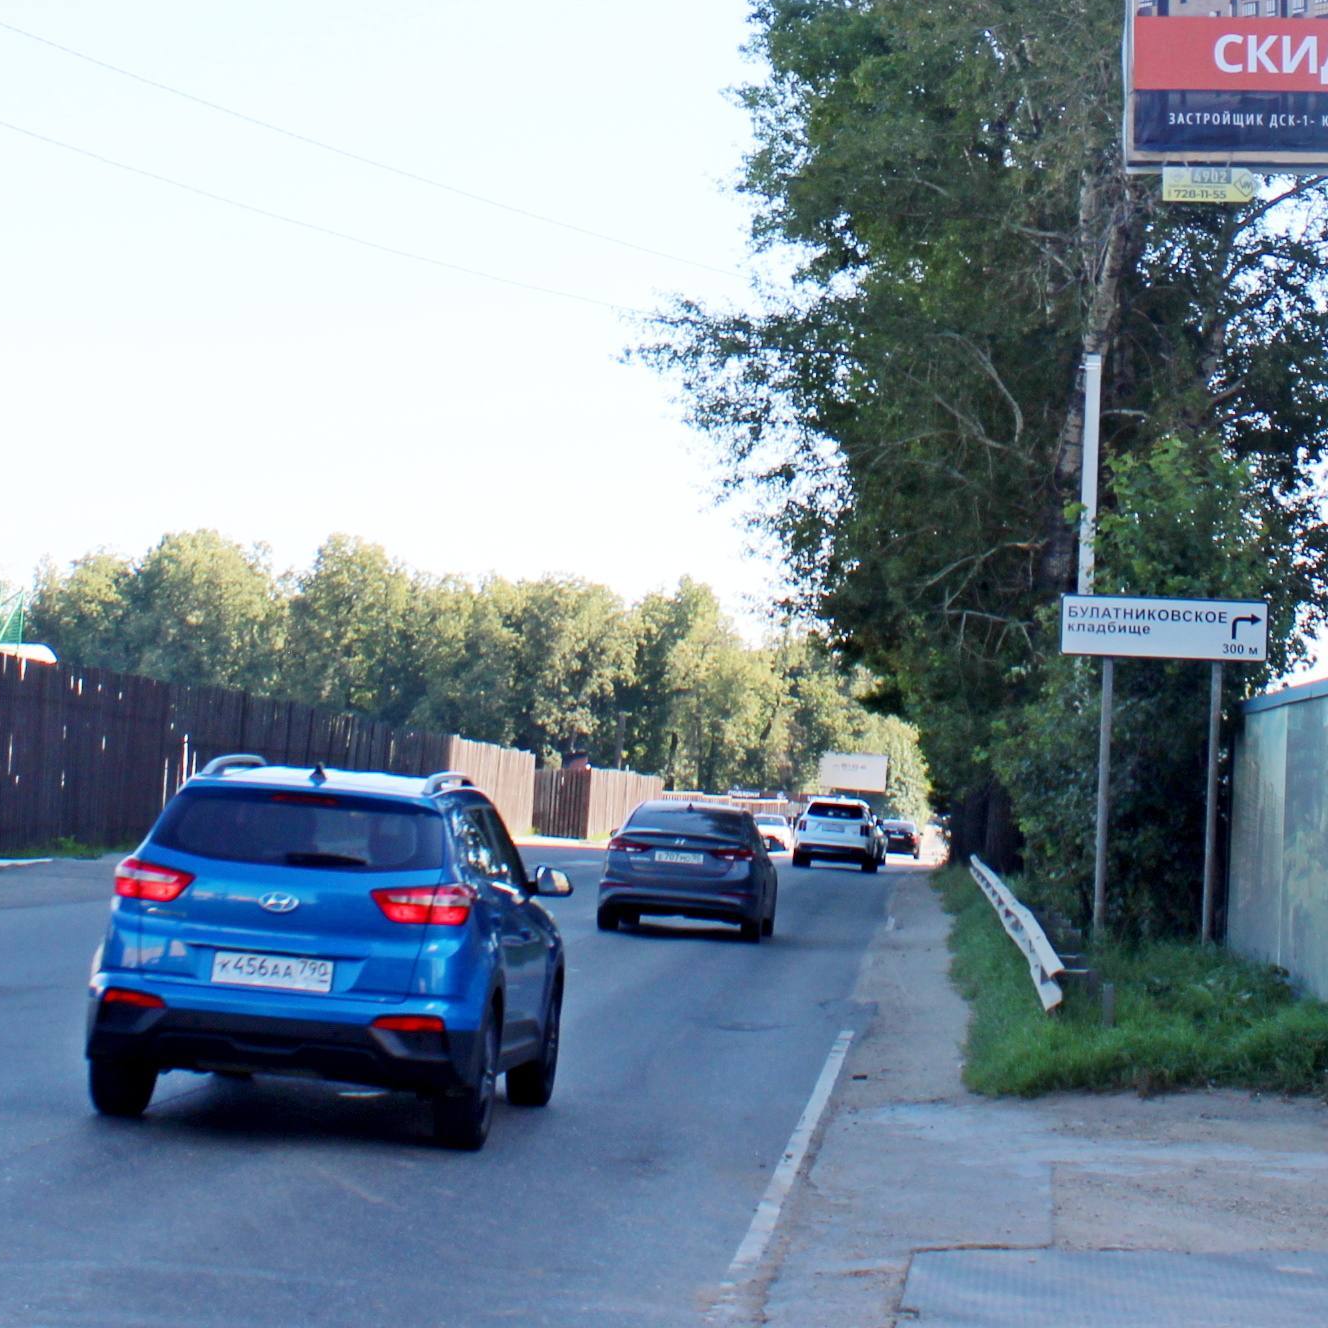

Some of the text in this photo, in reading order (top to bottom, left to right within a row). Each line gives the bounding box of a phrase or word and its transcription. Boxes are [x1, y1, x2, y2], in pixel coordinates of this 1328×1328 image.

[1168, 110, 1264, 129] ЗАСТРОЙЩИК
[1067, 606, 1228, 624] БУЛАТНИКОВСКОЕ
[1067, 622, 1151, 636] кладбище
[1222, 644, 1258, 655] 300 м
